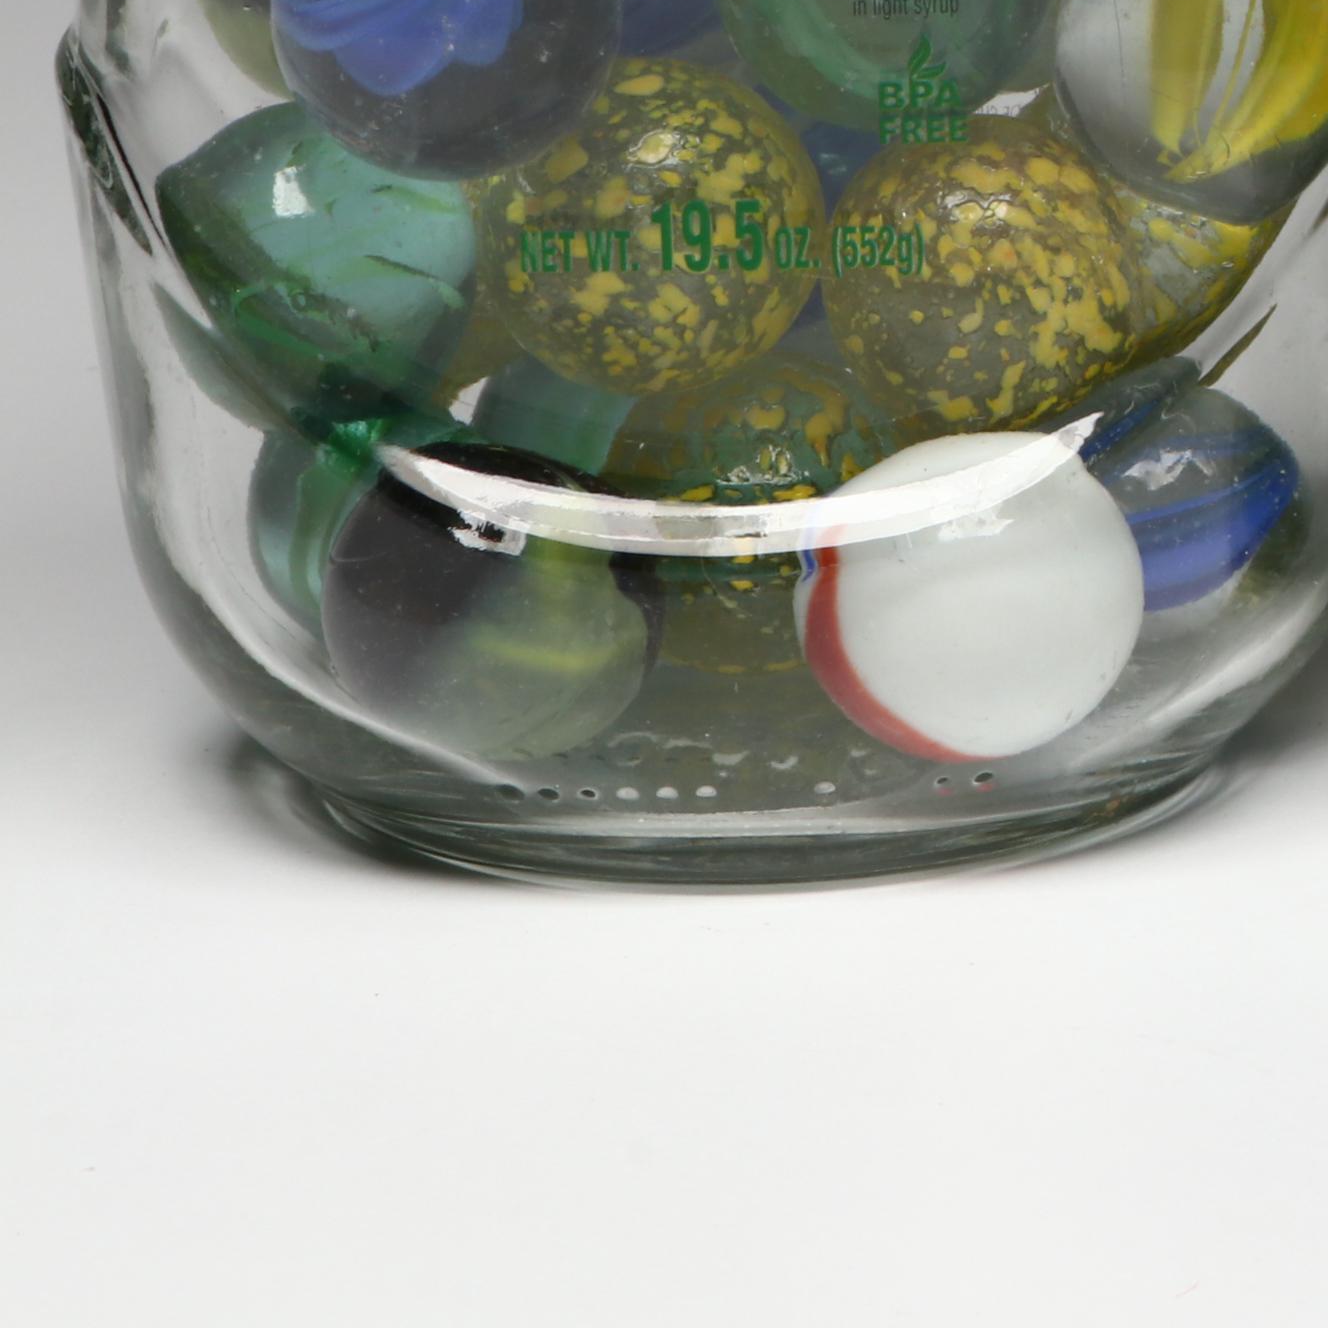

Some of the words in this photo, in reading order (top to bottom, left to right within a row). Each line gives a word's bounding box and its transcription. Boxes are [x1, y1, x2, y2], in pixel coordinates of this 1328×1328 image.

[878, 79, 962, 112] BPA
[878, 114, 970, 145] FREE
[519, 231, 576, 272] NET
[586, 230, 639, 272] WT.
[650, 199, 764, 273] 19.5
[830, 222, 926, 278] (552g)
